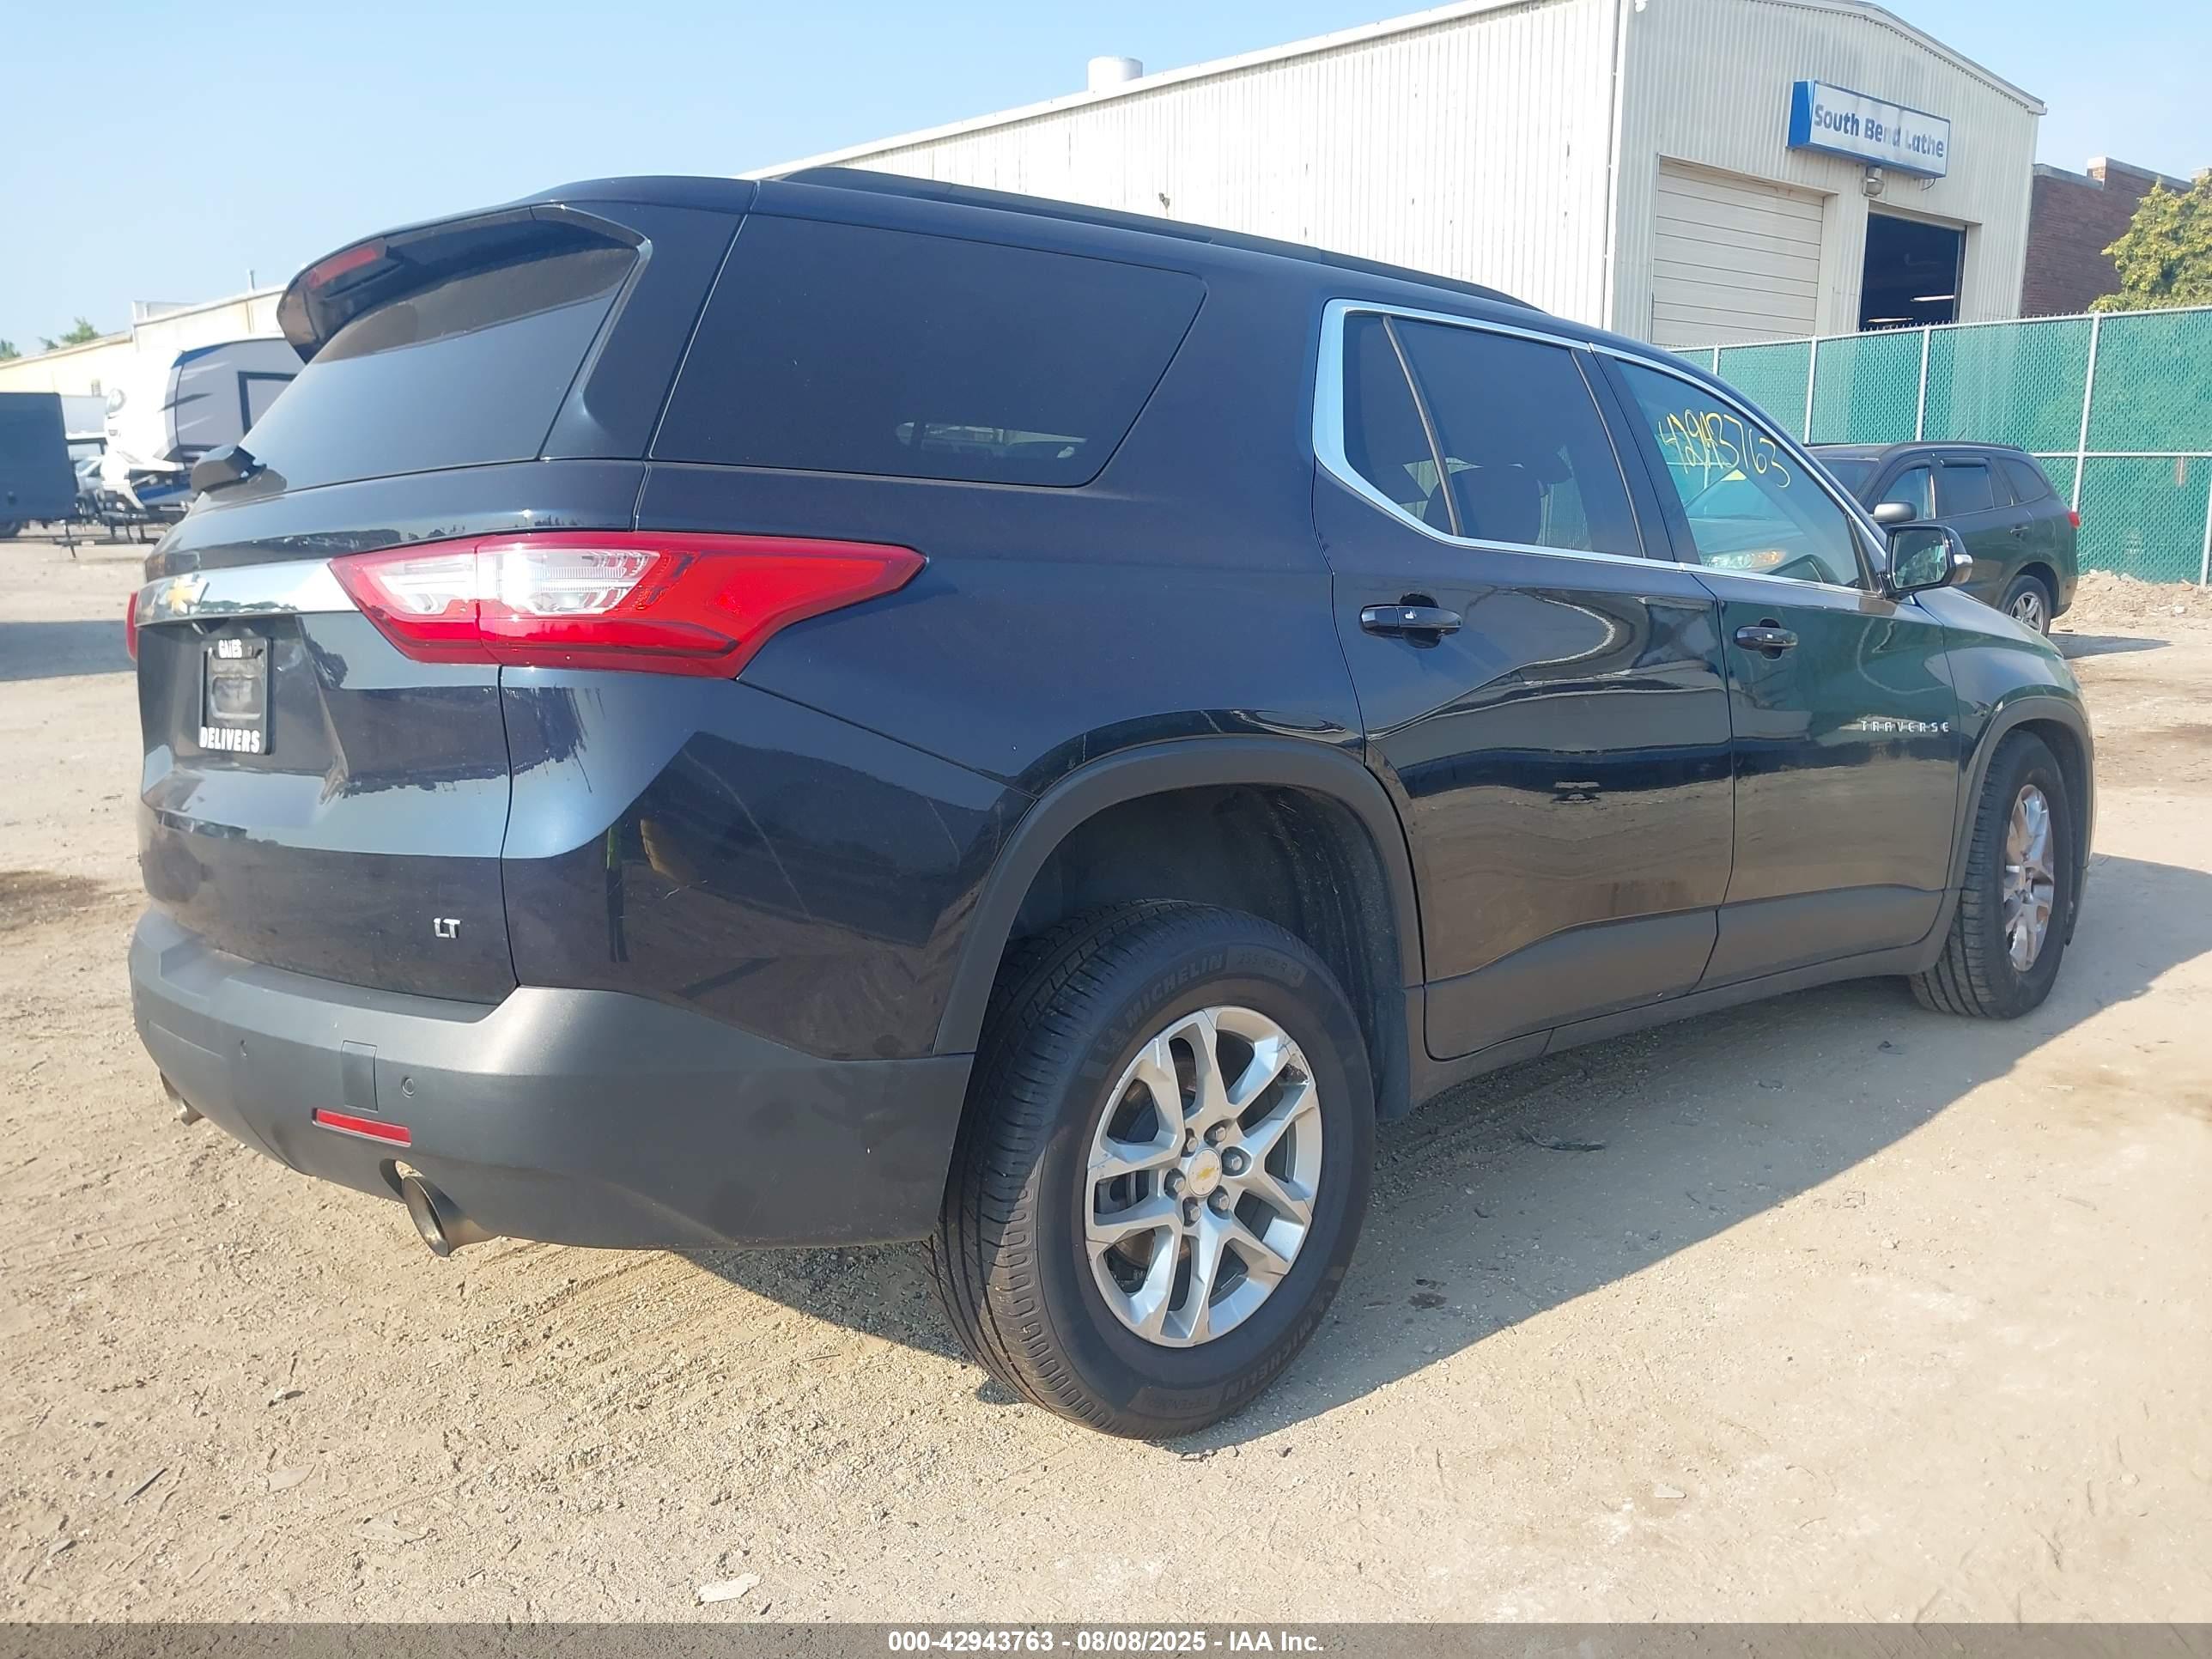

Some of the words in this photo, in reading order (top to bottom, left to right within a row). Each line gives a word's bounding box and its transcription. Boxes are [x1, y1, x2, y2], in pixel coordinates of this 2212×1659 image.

[1814, 104, 1859, 137] South
[1864, 117, 1901, 148] Bend
[1905, 128, 1945, 158] Lathe
[198, 726, 261, 753] DELIVERS
[1860, 720, 1950, 732] TRAVERSE
[433, 917, 461, 939] LT
[1125, 953, 1225, 1029] MICHELIN
